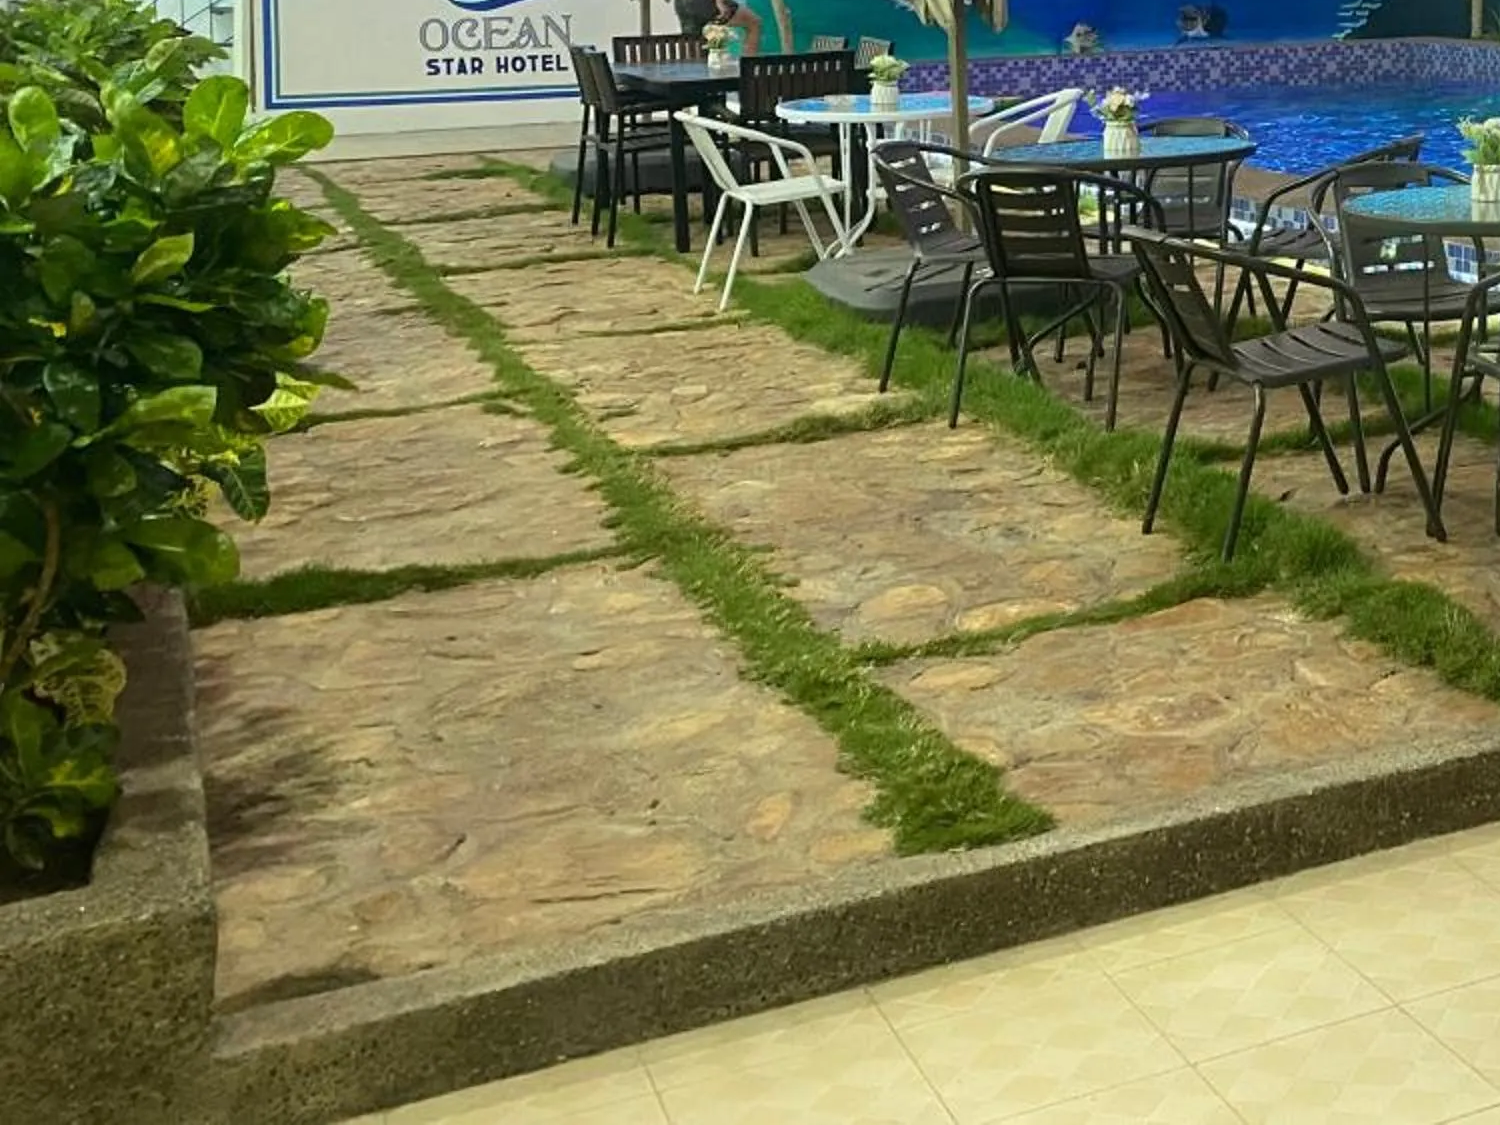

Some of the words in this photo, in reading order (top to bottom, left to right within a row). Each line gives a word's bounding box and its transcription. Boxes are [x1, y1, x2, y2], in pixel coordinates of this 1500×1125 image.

[419, 14, 573, 53] OCEAN
[426, 57, 484, 76] STAR
[496, 54, 569, 74] HOTEL
